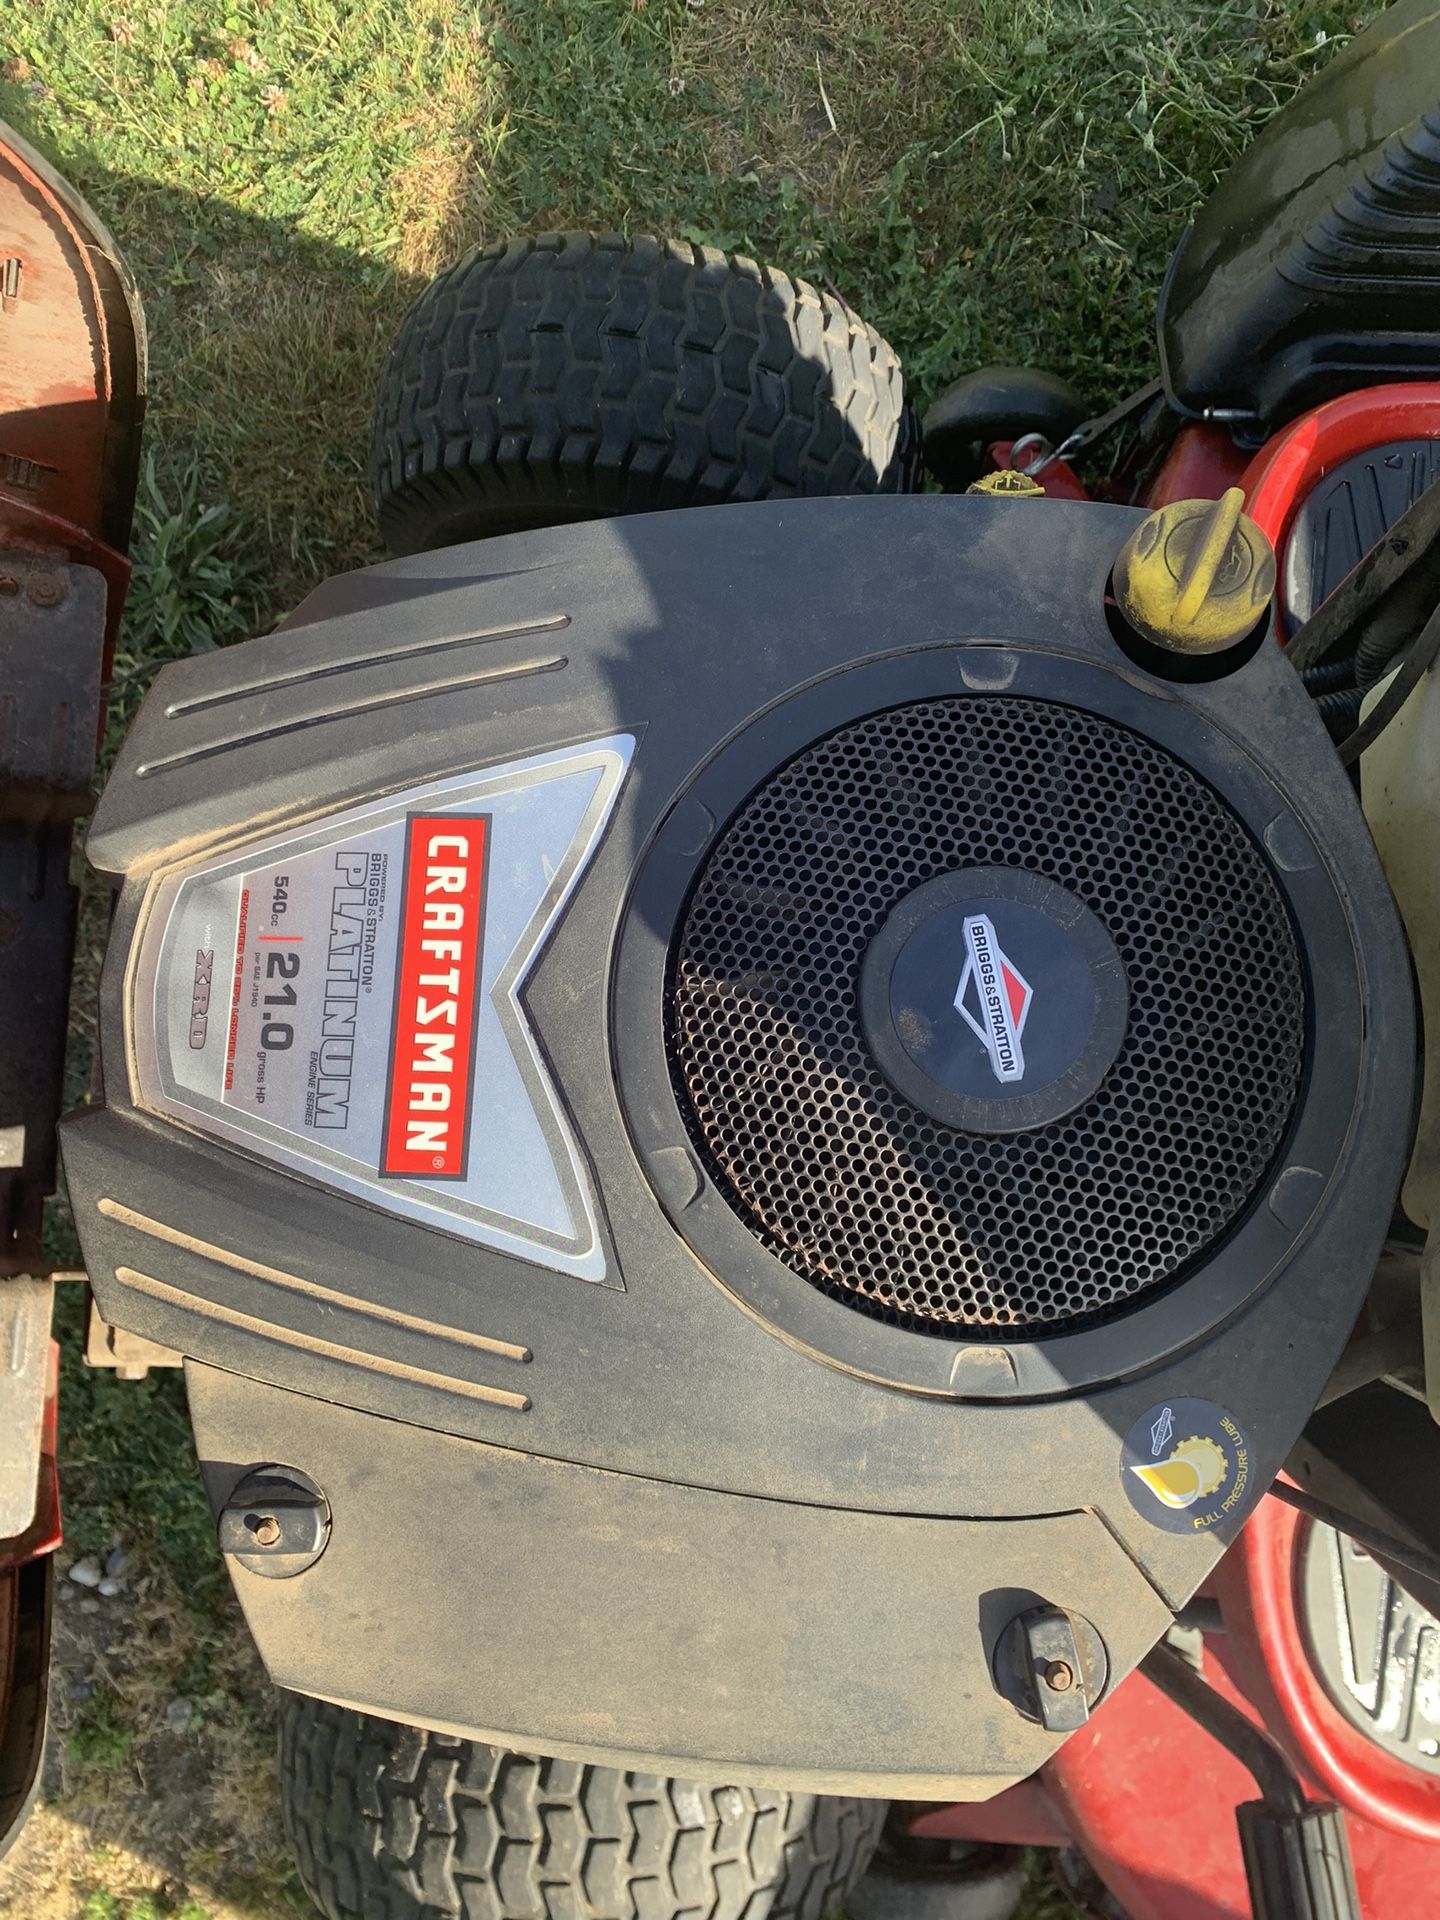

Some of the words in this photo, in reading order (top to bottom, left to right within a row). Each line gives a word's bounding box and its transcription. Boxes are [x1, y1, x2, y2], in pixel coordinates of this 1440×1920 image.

[379, 853, 388, 903] POWERED
[202, 923, 214, 949] with
[237, 889, 250, 954] QUALIFIED
[235, 956, 243, 975] TO
[188, 948, 214, 1050] XRD
[260, 951, 300, 1051] 21.0
[313, 851, 369, 1130] PLATINUM
[227, 1007, 239, 1061] LONGER
[225, 1063, 234, 1090] LIFE
[256, 1051, 268, 1083] gross
[307, 1051, 319, 1089] ENGINE
[255, 1087, 266, 1104] HP
[304, 1091, 316, 1127] SERIES
[1219, 1416, 1244, 1447] LUBE
[1221, 1449, 1248, 1513] PRESSURE
[1193, 1511, 1224, 1529] FULL
